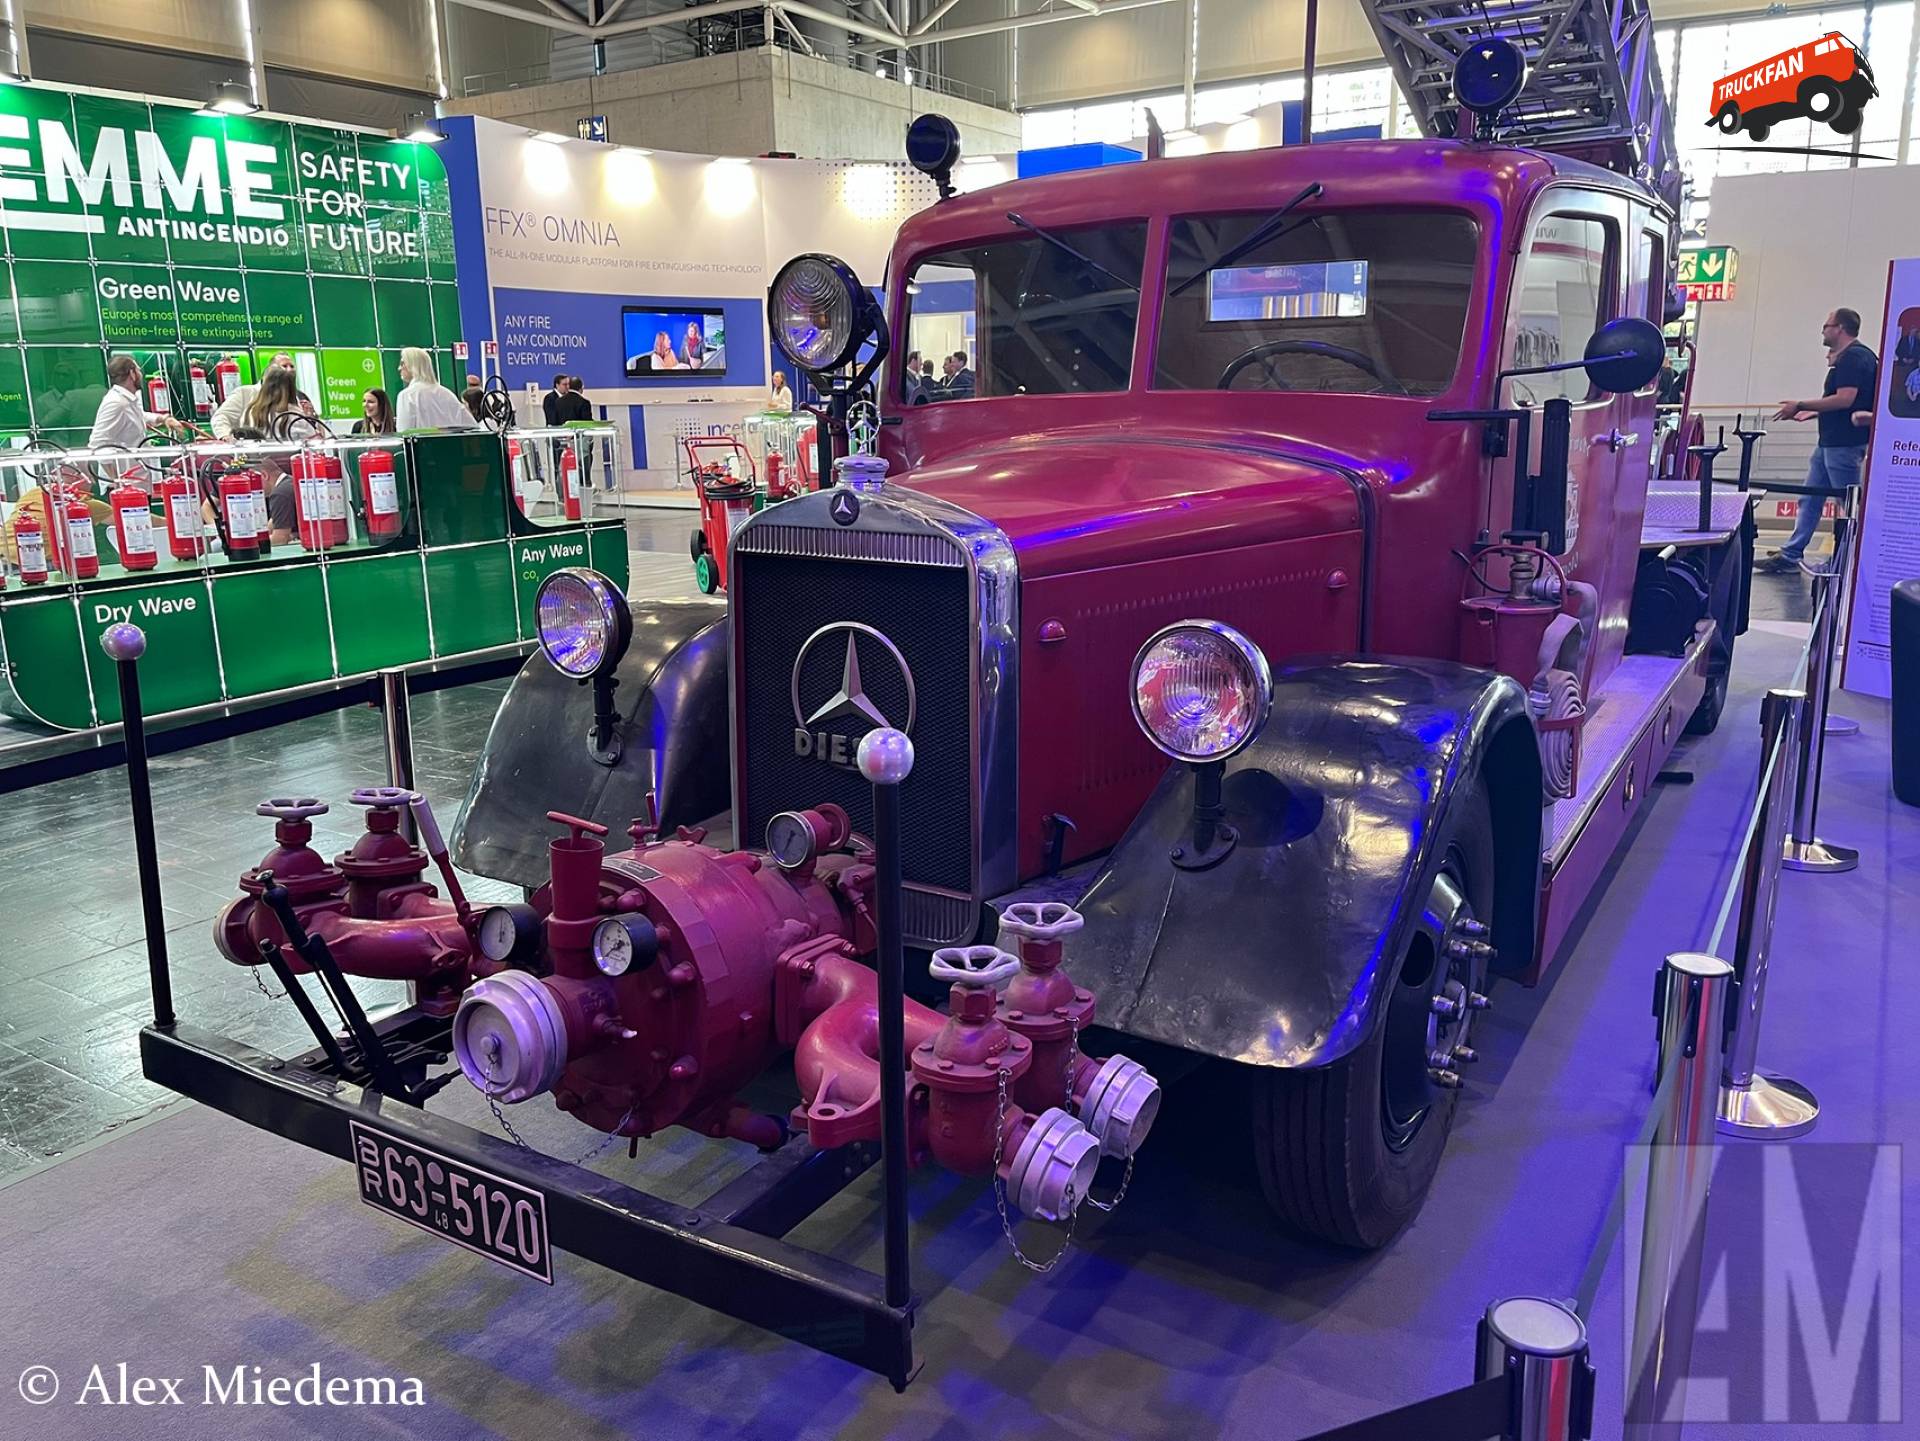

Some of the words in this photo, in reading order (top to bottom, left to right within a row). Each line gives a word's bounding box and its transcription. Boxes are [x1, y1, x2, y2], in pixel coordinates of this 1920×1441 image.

[300, 152, 410, 190] SAFETY
[304, 188, 363, 219] FOR
[118, 217, 289, 246] ANTINCENDIO
[307, 223, 419, 257] FUTURE
[544, 215, 620, 247] OMNIA
[489, 248, 504, 258] THE
[505, 250, 545, 261] ALL-IN-ONE
[546, 254, 580, 264] MODULAR
[582, 257, 618, 267] PLATFORM
[619, 260, 634, 269] FOR
[636, 261, 651, 270] FIRE
[653, 262, 710, 272] EXTINGUISHING
[712, 265, 762, 274] TECHNOLOGY
[99, 277, 171, 300] Green
[177, 280, 240, 303] Wave
[103, 309, 148, 322] Europe's
[263, 314, 291, 325] range
[504, 315, 526, 328] ANY
[529, 316, 551, 329] FIRE
[105, 324, 175, 337] fluorine-free
[181, 326, 198, 337] fire
[506, 334, 527, 347] ANY
[530, 334, 587, 347] CONDITION
[507, 352, 540, 365] EVERY
[542, 352, 566, 365] TIME
[327, 377, 356, 386] Green
[328, 392, 356, 401] Wave
[330, 405, 350, 414] Plus
[521, 548, 546, 564] Any
[549, 544, 583, 559] Wave
[94, 604, 133, 625] Dry
[138, 597, 197, 617] Wave
